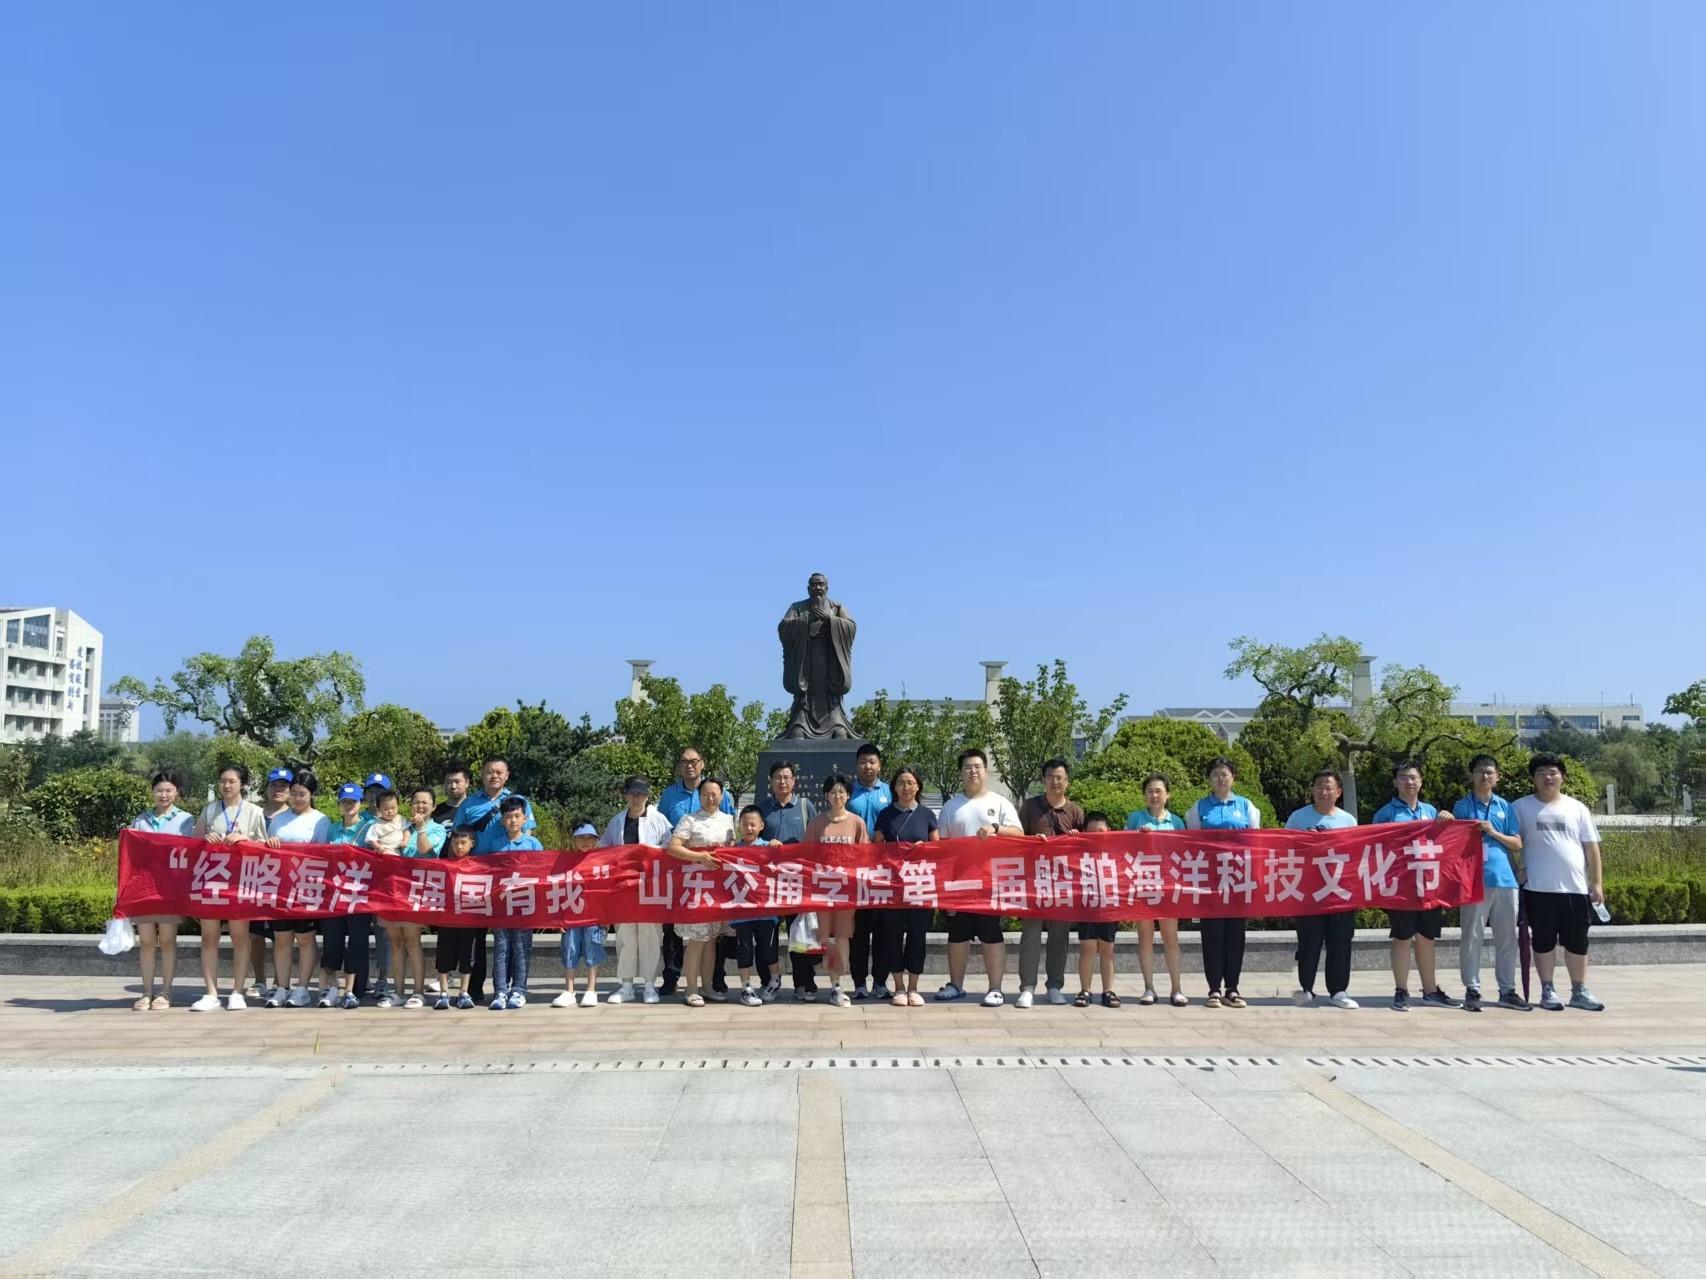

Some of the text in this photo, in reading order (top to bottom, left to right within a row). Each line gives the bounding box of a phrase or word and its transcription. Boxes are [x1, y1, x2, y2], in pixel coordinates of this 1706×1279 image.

[820, 835, 853, 844] PLEASE
[169, 847, 373, 913] “经略海洋
[408, 865, 610, 917] 强国有我”
